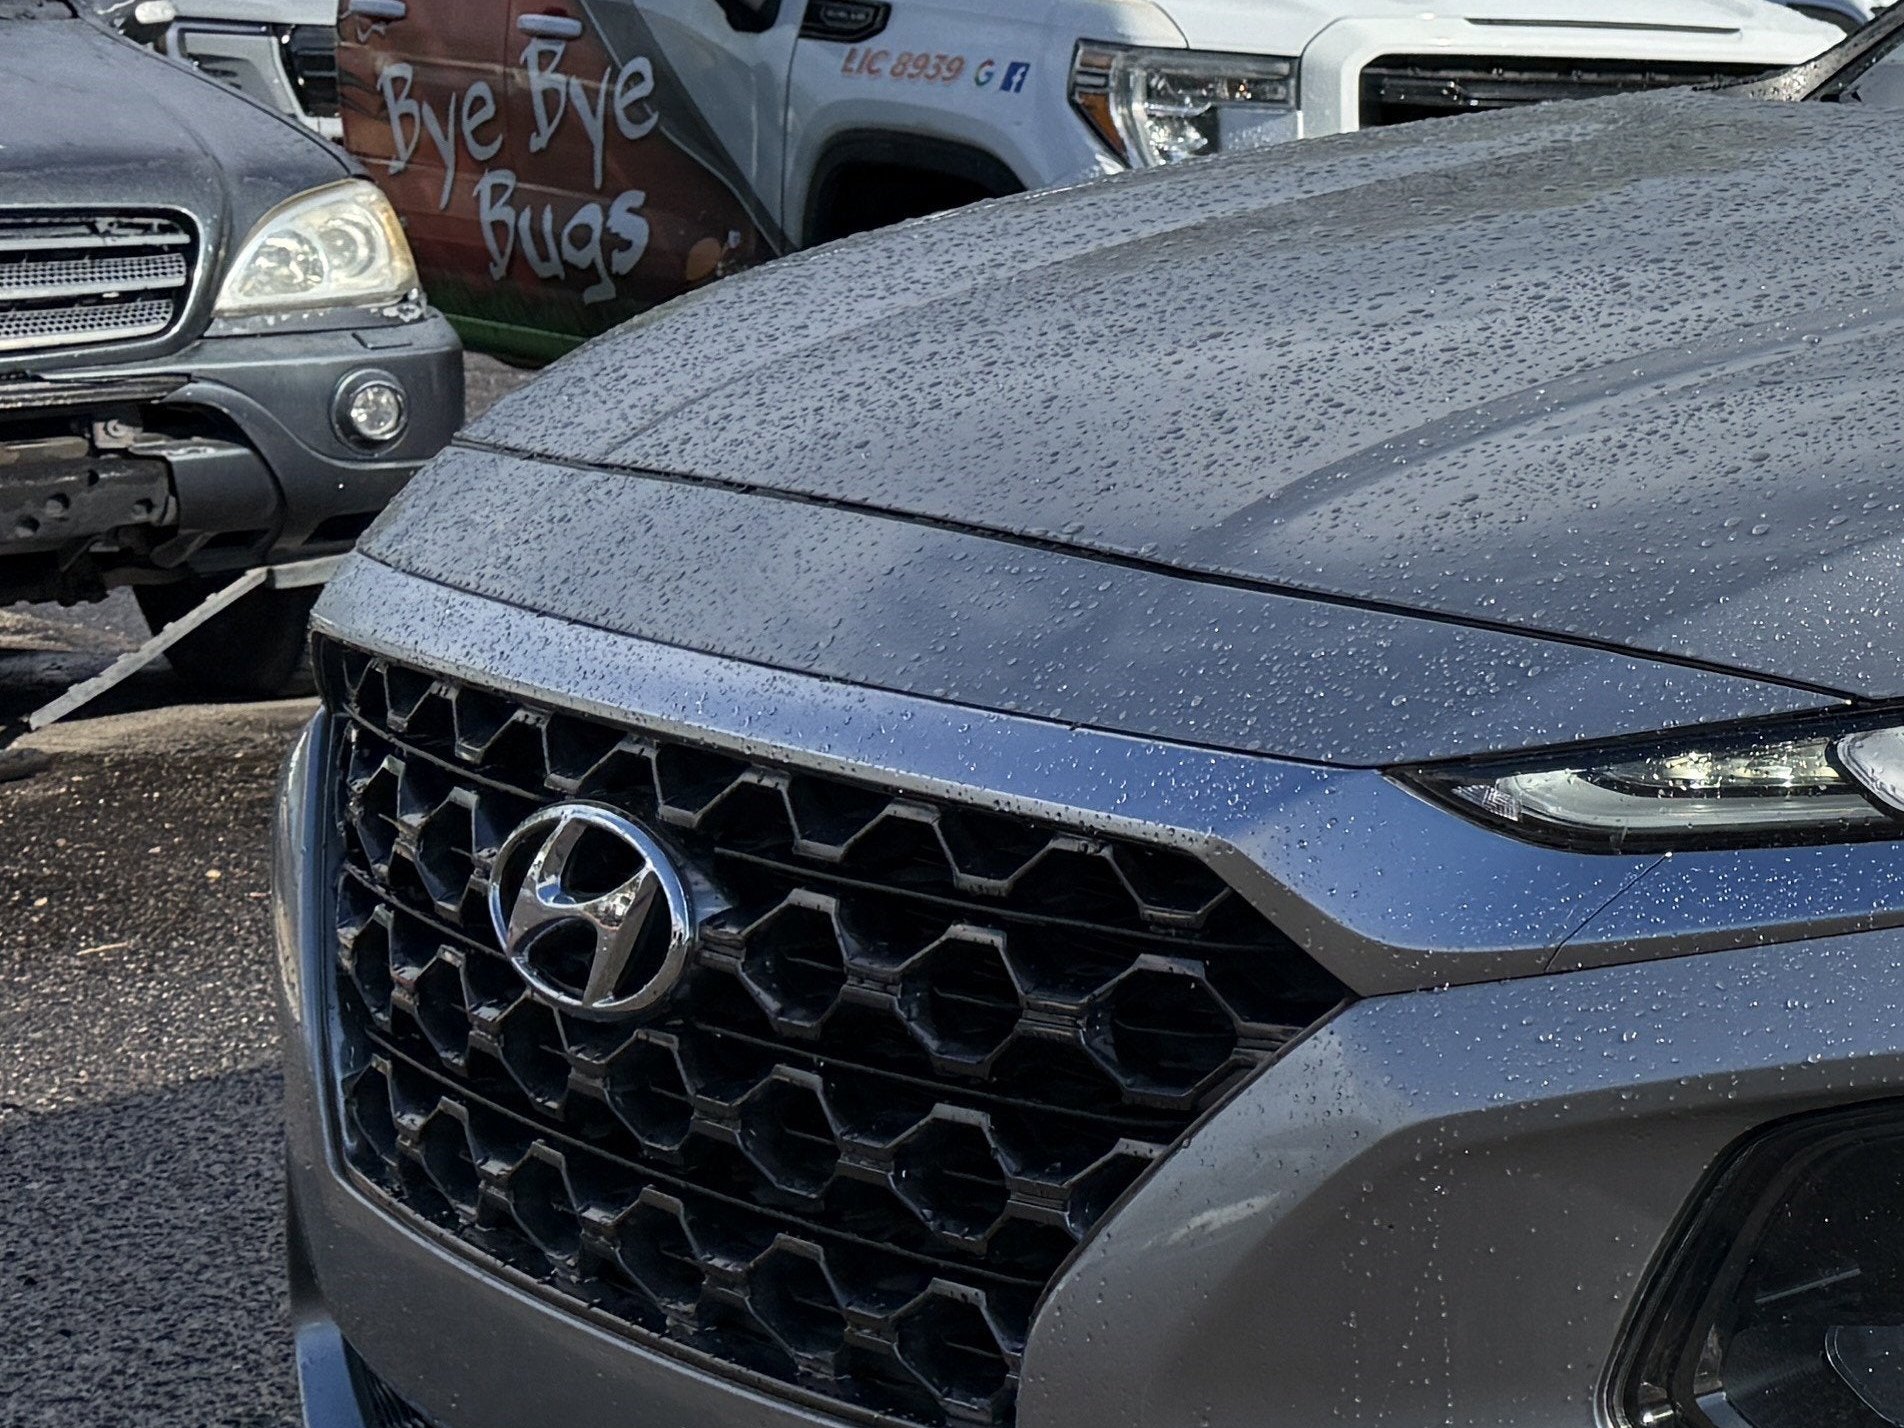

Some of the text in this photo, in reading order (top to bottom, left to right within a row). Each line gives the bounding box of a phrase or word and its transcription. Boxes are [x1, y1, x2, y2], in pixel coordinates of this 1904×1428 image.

[376, 37, 659, 211] Bye Bye
[841, 47, 889, 76] LIC
[889, 51, 966, 84] 8939
[472, 168, 650, 305] Bugs
